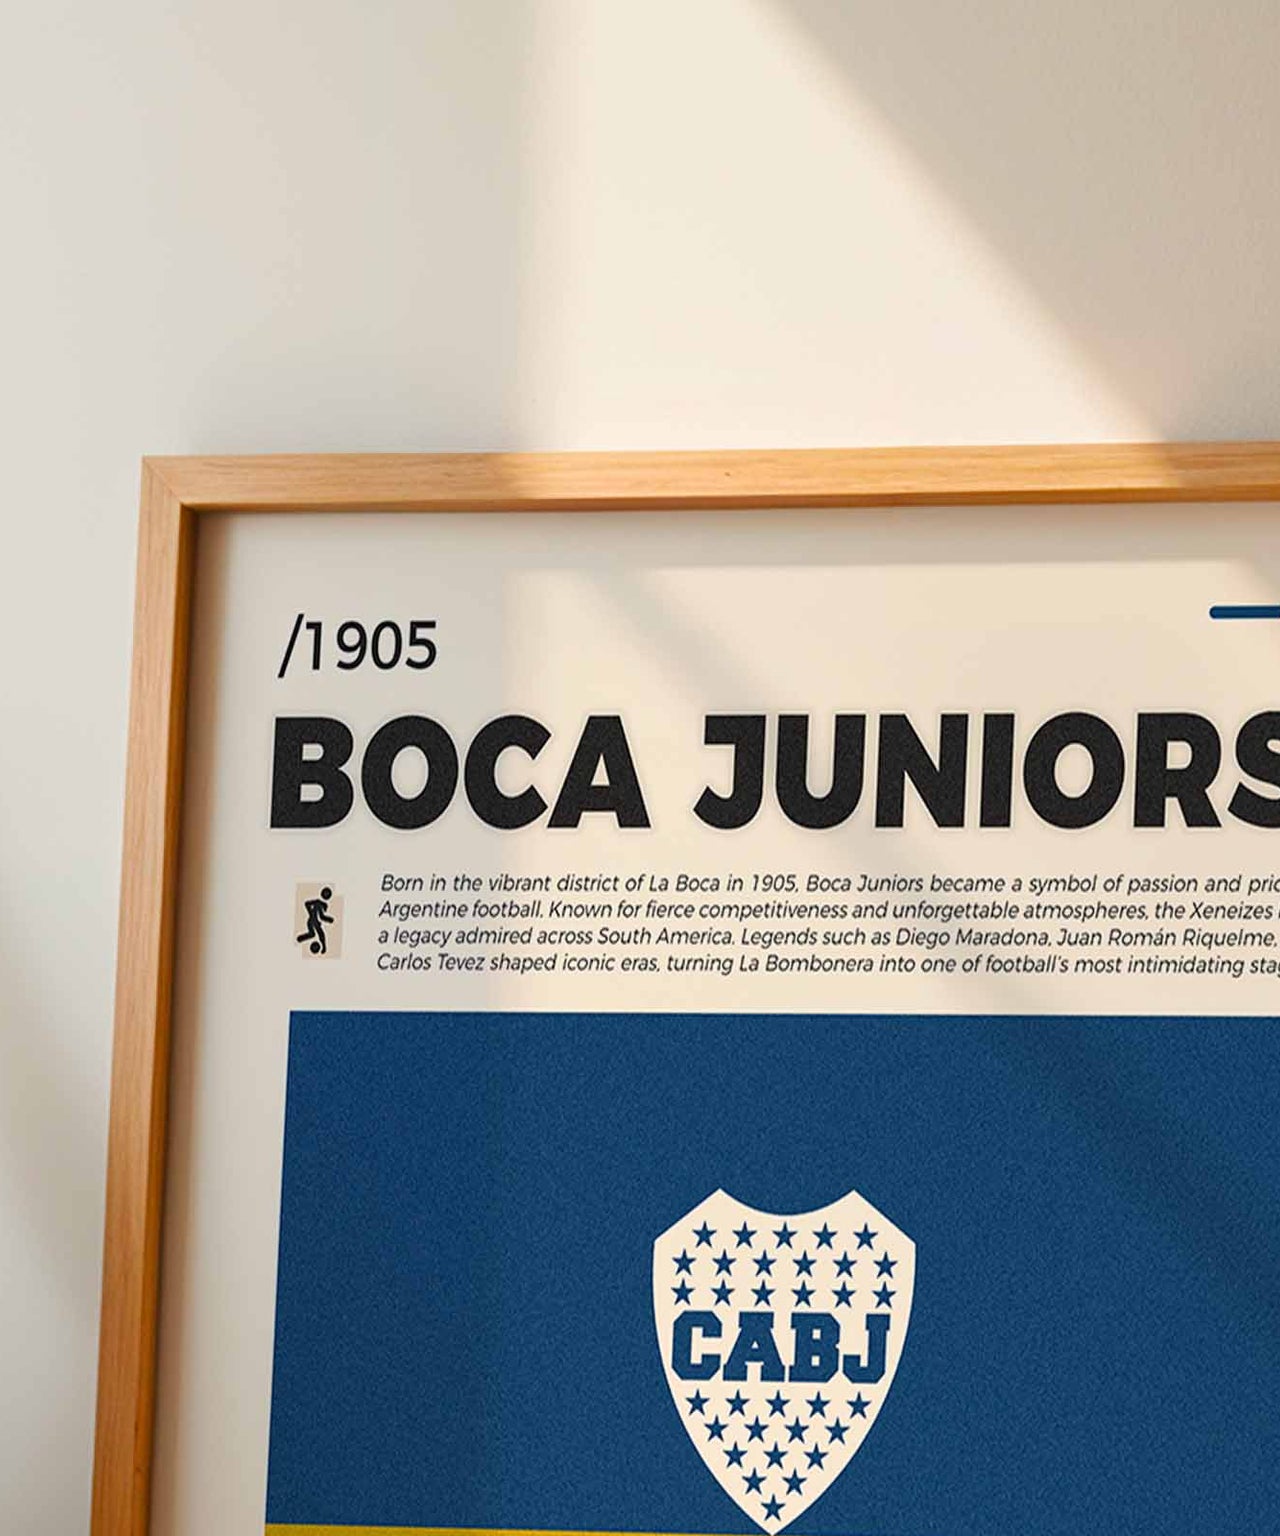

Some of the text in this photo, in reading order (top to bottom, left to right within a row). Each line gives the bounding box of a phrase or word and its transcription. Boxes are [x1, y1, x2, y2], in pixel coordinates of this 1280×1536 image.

[277, 614, 438, 679] /1905
[269, 714, 652, 831] BOCA
[381, 873, 424, 892] Born
[429, 873, 447, 892] in
[453, 873, 483, 892] the
[489, 873, 552, 892] vibrant
[556, 873, 620, 893] district
[625, 873, 647, 893] of
[649, 874, 669, 893] La
[675, 873, 721, 893] Boca
[726, 873, 744, 892] in
[753, 873, 799, 893] 1905,
[806, 874, 852, 893] Boca
[856, 873, 924, 893] Juniors
[930, 874, 1006, 893] became
[1011, 877, 1023, 893] a
[1028, 874, 1098, 897] symbol
[1102, 873, 1125, 893] of
[1126, 873, 1199, 897] passion
[1204, 874, 1243, 893] and
[378, 899, 469, 922] Argentine
[472, 899, 544, 919] football.
[548, 900, 613, 919] Known
[617, 899, 643, 919] for
[645, 899, 696, 919] fierce
[698, 900, 849, 923] competitiveness
[851, 900, 889, 920] and
[892, 899, 1020, 924] unforgettable
[1023, 900, 1149, 924] atmospheres,
[1155, 901, 1186, 920] the
[1189, 900, 1274, 920] Xeneizes
[377, 930, 389, 945] a
[393, 926, 453, 949] legacy
[455, 926, 534, 945] admired
[536, 930, 593, 945] across
[597, 926, 652, 945] South
[655, 926, 735, 946] America.
[741, 927, 818, 950] Legends
[822, 927, 866, 946] such
[870, 931, 891, 946] as
[896, 927, 951, 950] Diego
[955, 927, 1052, 947] Maradona,
[1056, 927, 1103, 947] Juan
[1107, 927, 1177, 947] Román
[1182, 927, 1278, 951] Riquelme,
[377, 952, 432, 971] Carlos
[438, 952, 486, 972] Tevez
[489, 952, 558, 975] shaped
[562, 953, 616, 972] iconic
[620, 957, 660, 973] eras,
[667, 953, 734, 977] turning
[739, 954, 760, 973] La
[765, 953, 874, 973] Bombonera
[879, 954, 916, 973] into
[920, 958, 957, 974] one
[961, 953, 983, 974] of
[985, 954, 1069, 974] football's
[1074, 957, 1123, 974] most
[1127, 954, 1245, 979] intimidating
[671, 1310, 891, 1384] CABJ
